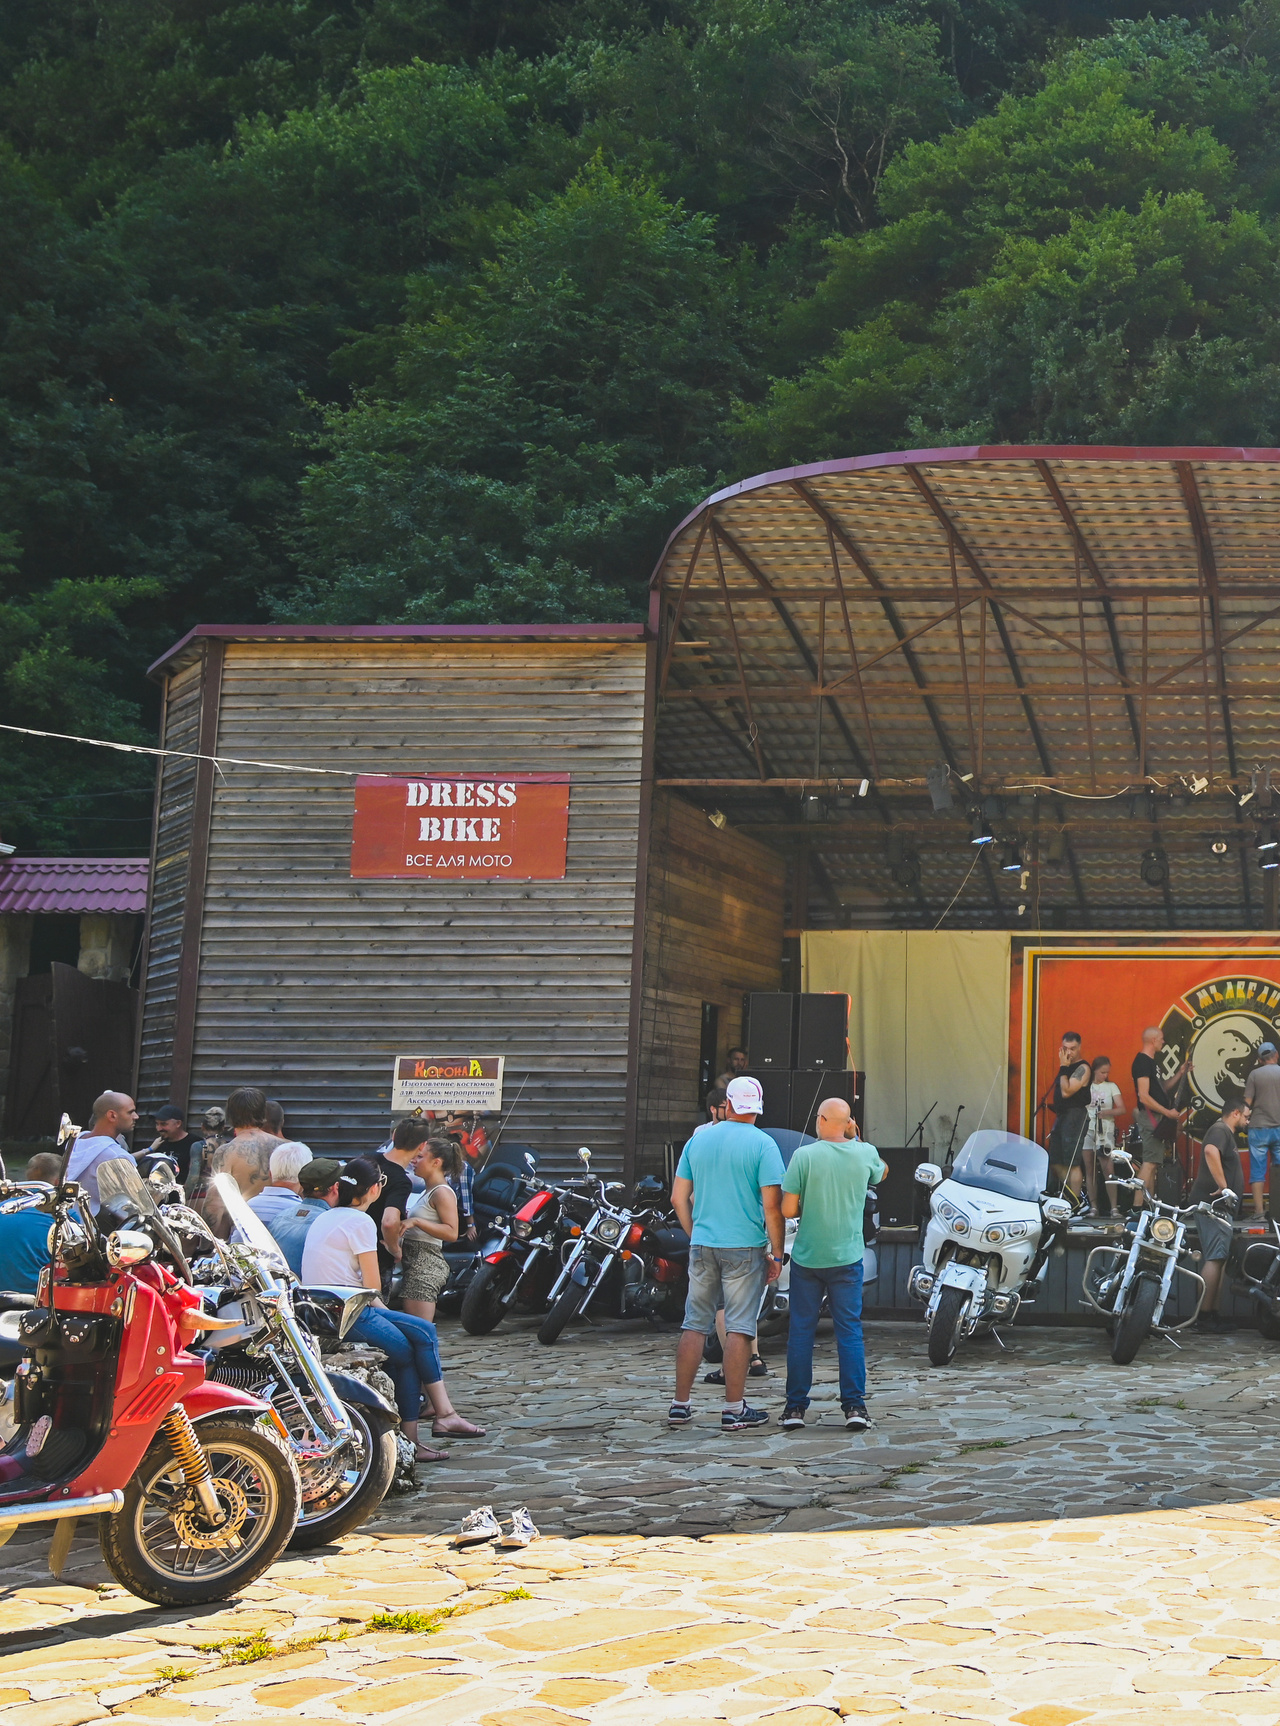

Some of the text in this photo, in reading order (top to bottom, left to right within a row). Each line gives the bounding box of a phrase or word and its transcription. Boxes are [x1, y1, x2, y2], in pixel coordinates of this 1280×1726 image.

[406, 783, 517, 807] DRESS
[418, 817, 501, 842] BIKE
[406, 854, 513, 868] ВСЕ ДЛЯ МОТО
